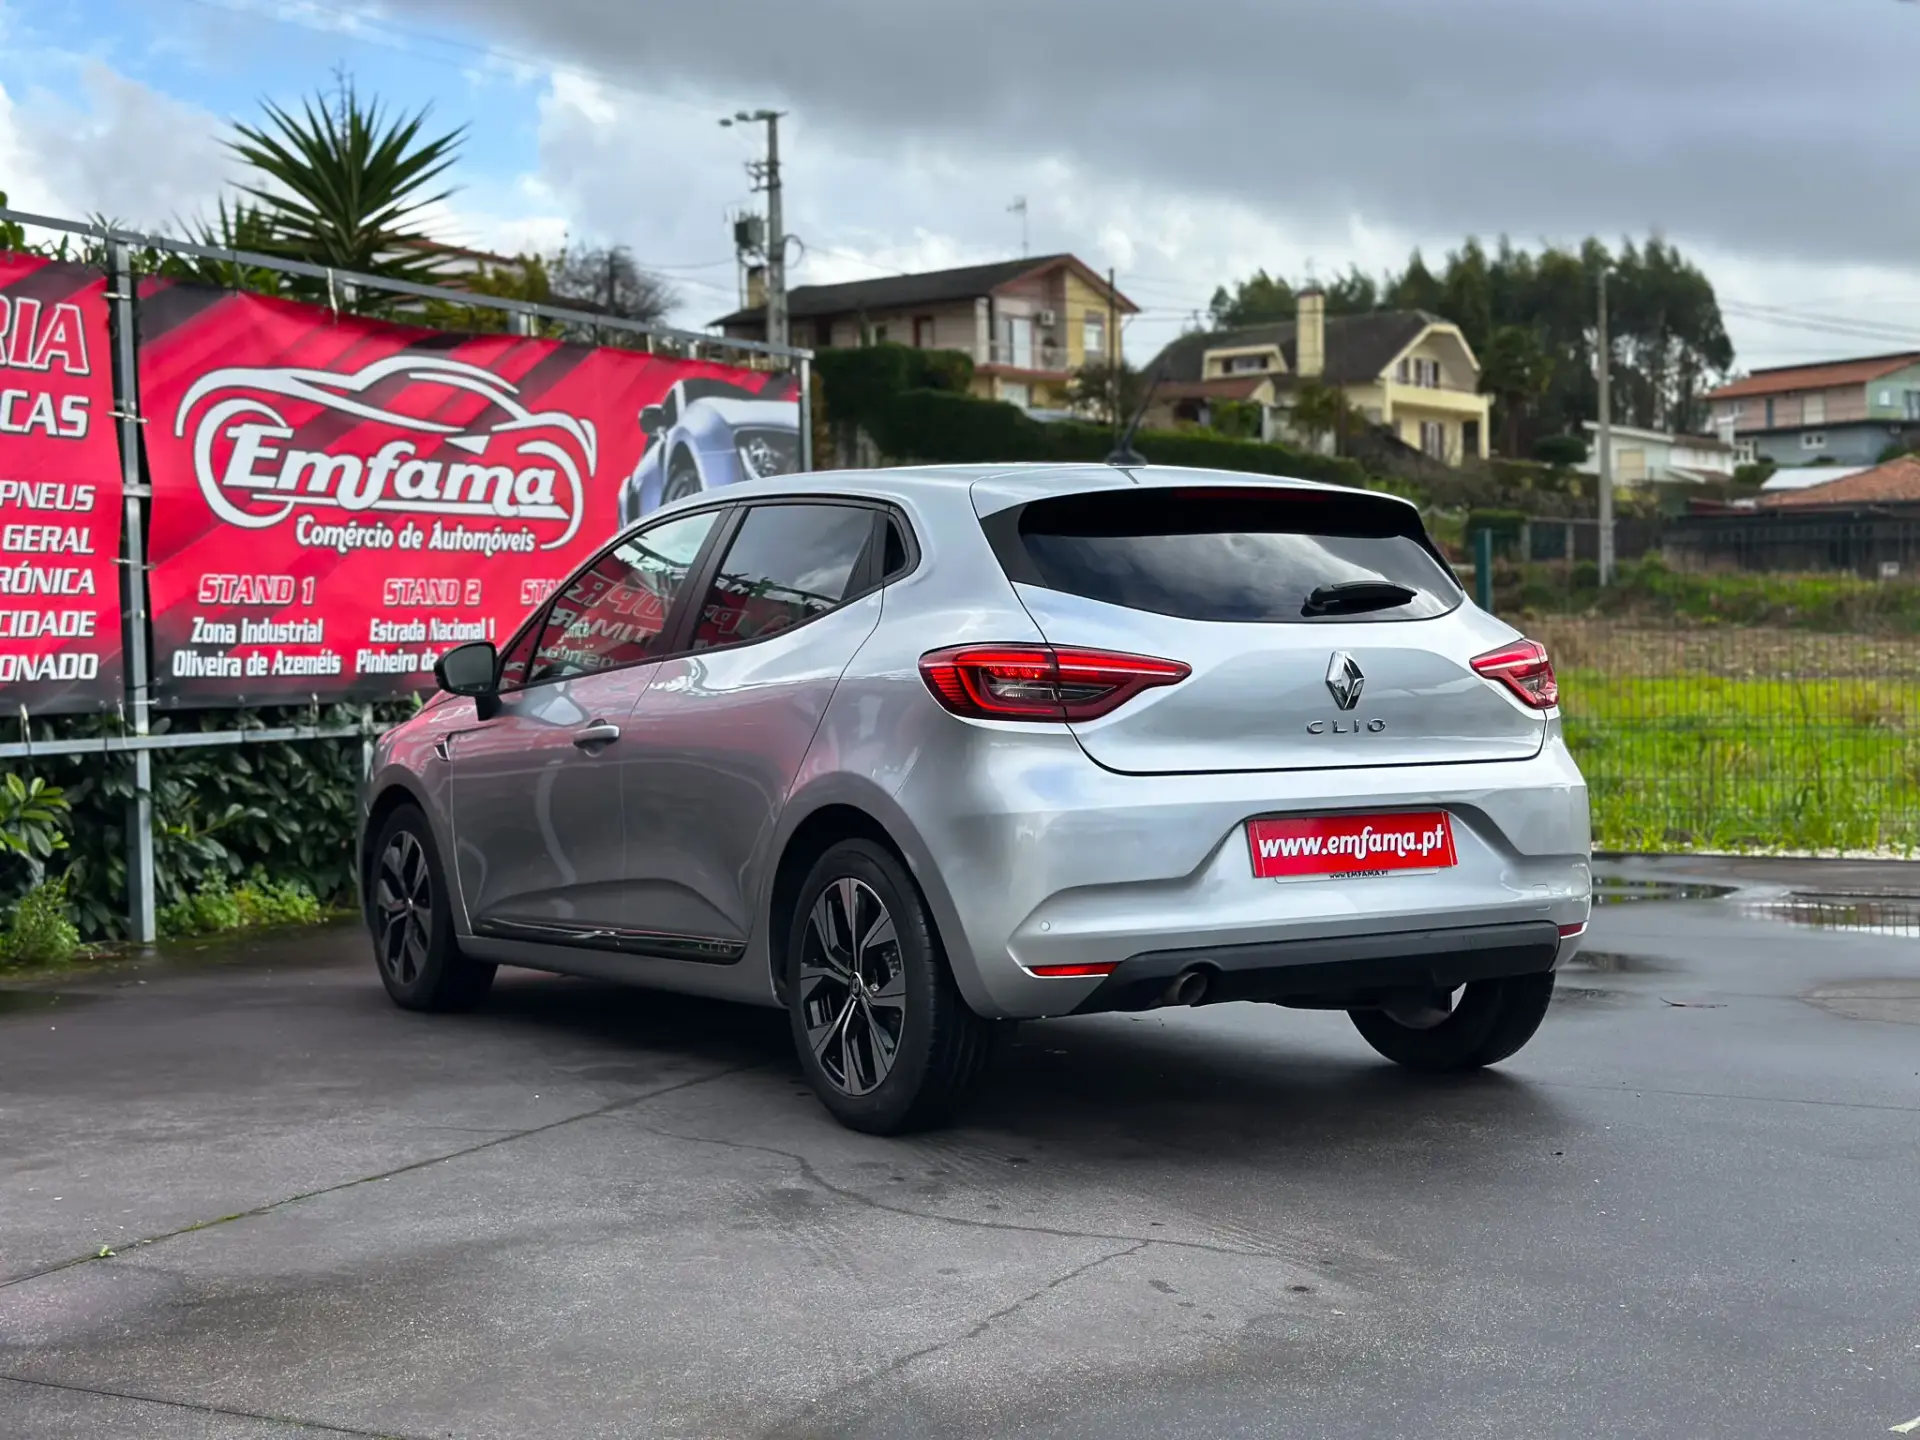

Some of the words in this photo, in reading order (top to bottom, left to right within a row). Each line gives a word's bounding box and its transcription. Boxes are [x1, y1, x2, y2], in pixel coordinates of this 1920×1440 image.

[0, 389, 89, 437] CAS
[222, 422, 556, 517] Emfama
[0, 480, 96, 511] PNEUS
[3, 524, 95, 554] GERAL
[296, 514, 394, 553] Comércio
[398, 521, 424, 549] de
[428, 519, 536, 557] Automóveis
[198, 573, 295, 604] STAND
[302, 576, 315, 604] 1
[383, 578, 460, 605] STAND
[464, 579, 481, 605] 2
[190, 616, 237, 644] Zona
[241, 617, 324, 643] Industrial
[369, 618, 426, 642] Estrada
[428, 618, 486, 641] Nacional
[172, 649, 242, 677] Oliveira
[246, 651, 269, 676] de
[272, 648, 342, 676] Azeméis
[355, 648, 418, 673] Pinheiro
[1306, 718, 1386, 734] CLIO
[1258, 824, 1444, 860] www.emfama.pt
